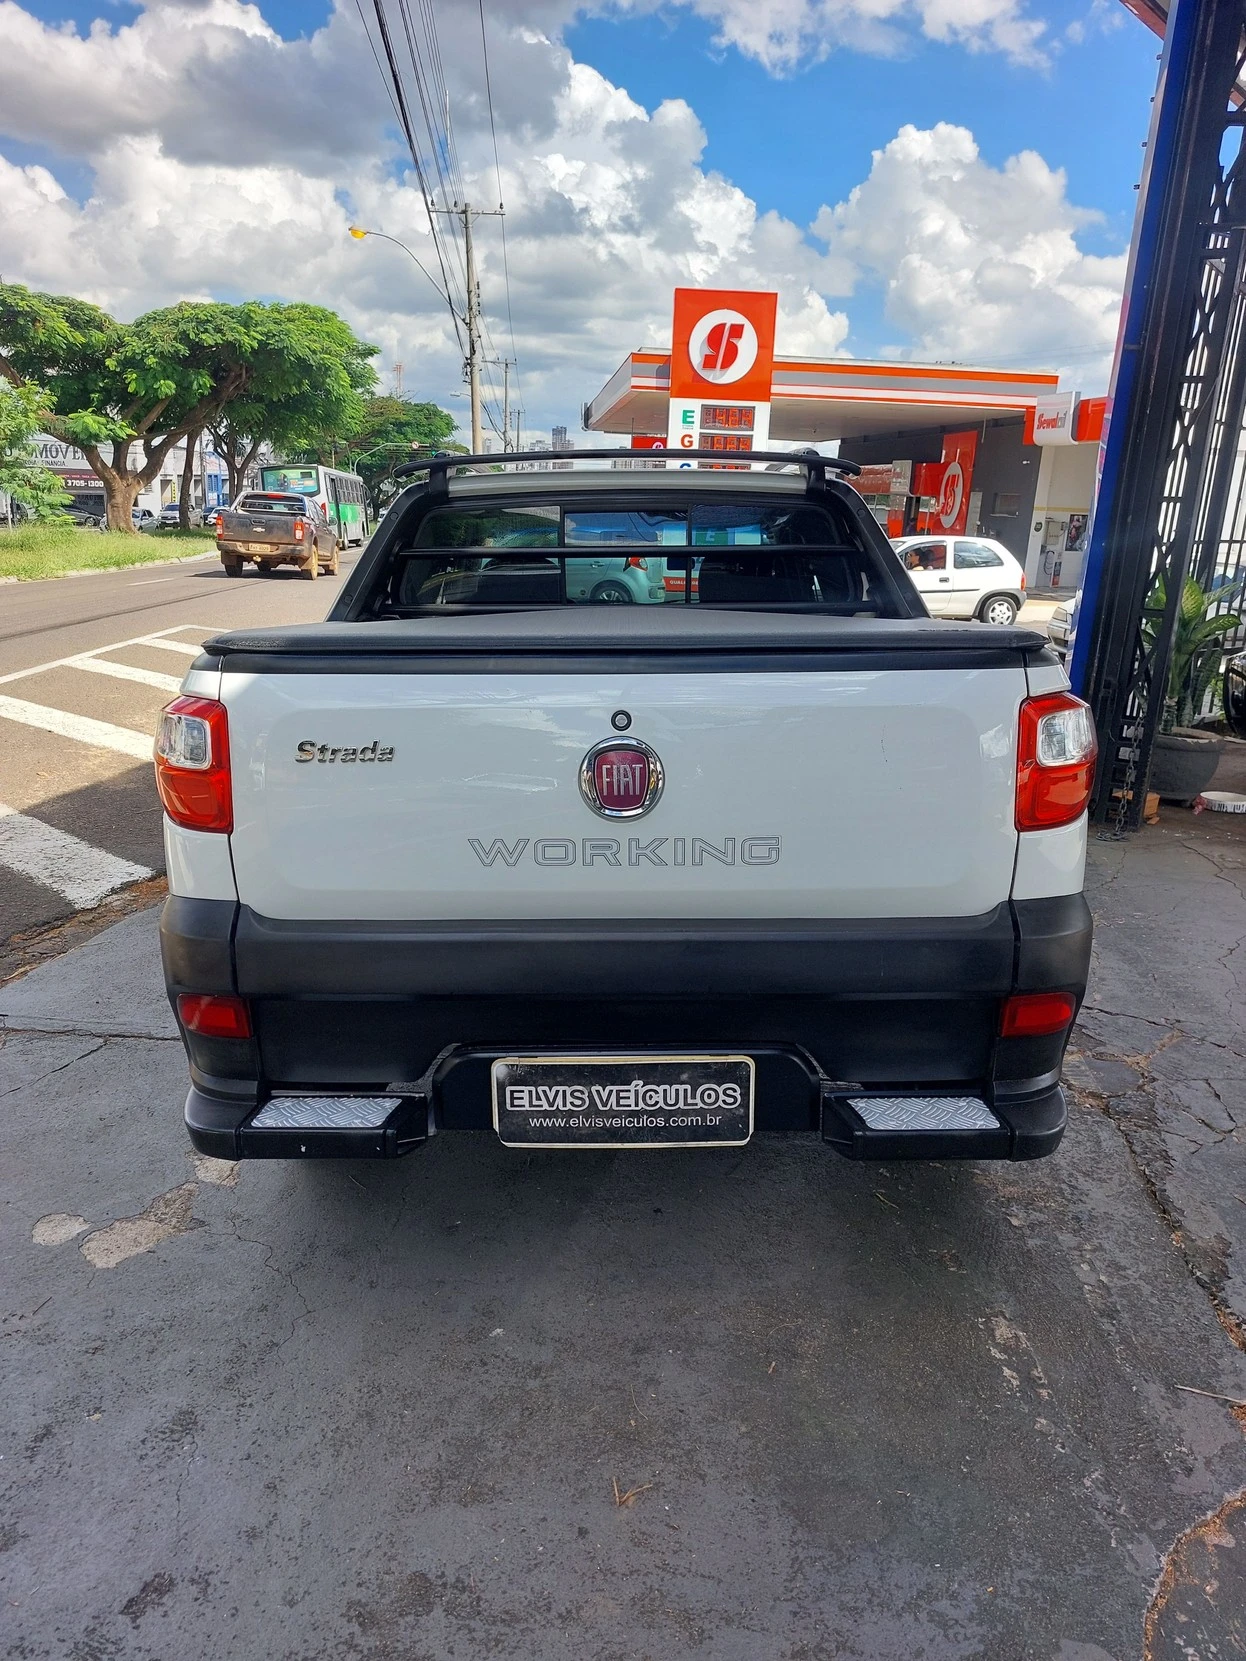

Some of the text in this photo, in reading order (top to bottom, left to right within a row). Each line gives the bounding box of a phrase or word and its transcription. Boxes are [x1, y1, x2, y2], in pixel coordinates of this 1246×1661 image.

[682, 409, 695, 424] E
[680, 433, 693, 448] G
[66, 479, 104, 488] 3705-1300
[295, 739, 396, 763] Strada
[601, 763, 644, 797] FIAT
[467, 835, 782, 868] WORKING
[505, 1080, 741, 1111] ELVIS VEÍCULOS
[528, 1114, 722, 1128] www.elvisveiculos.com.br
